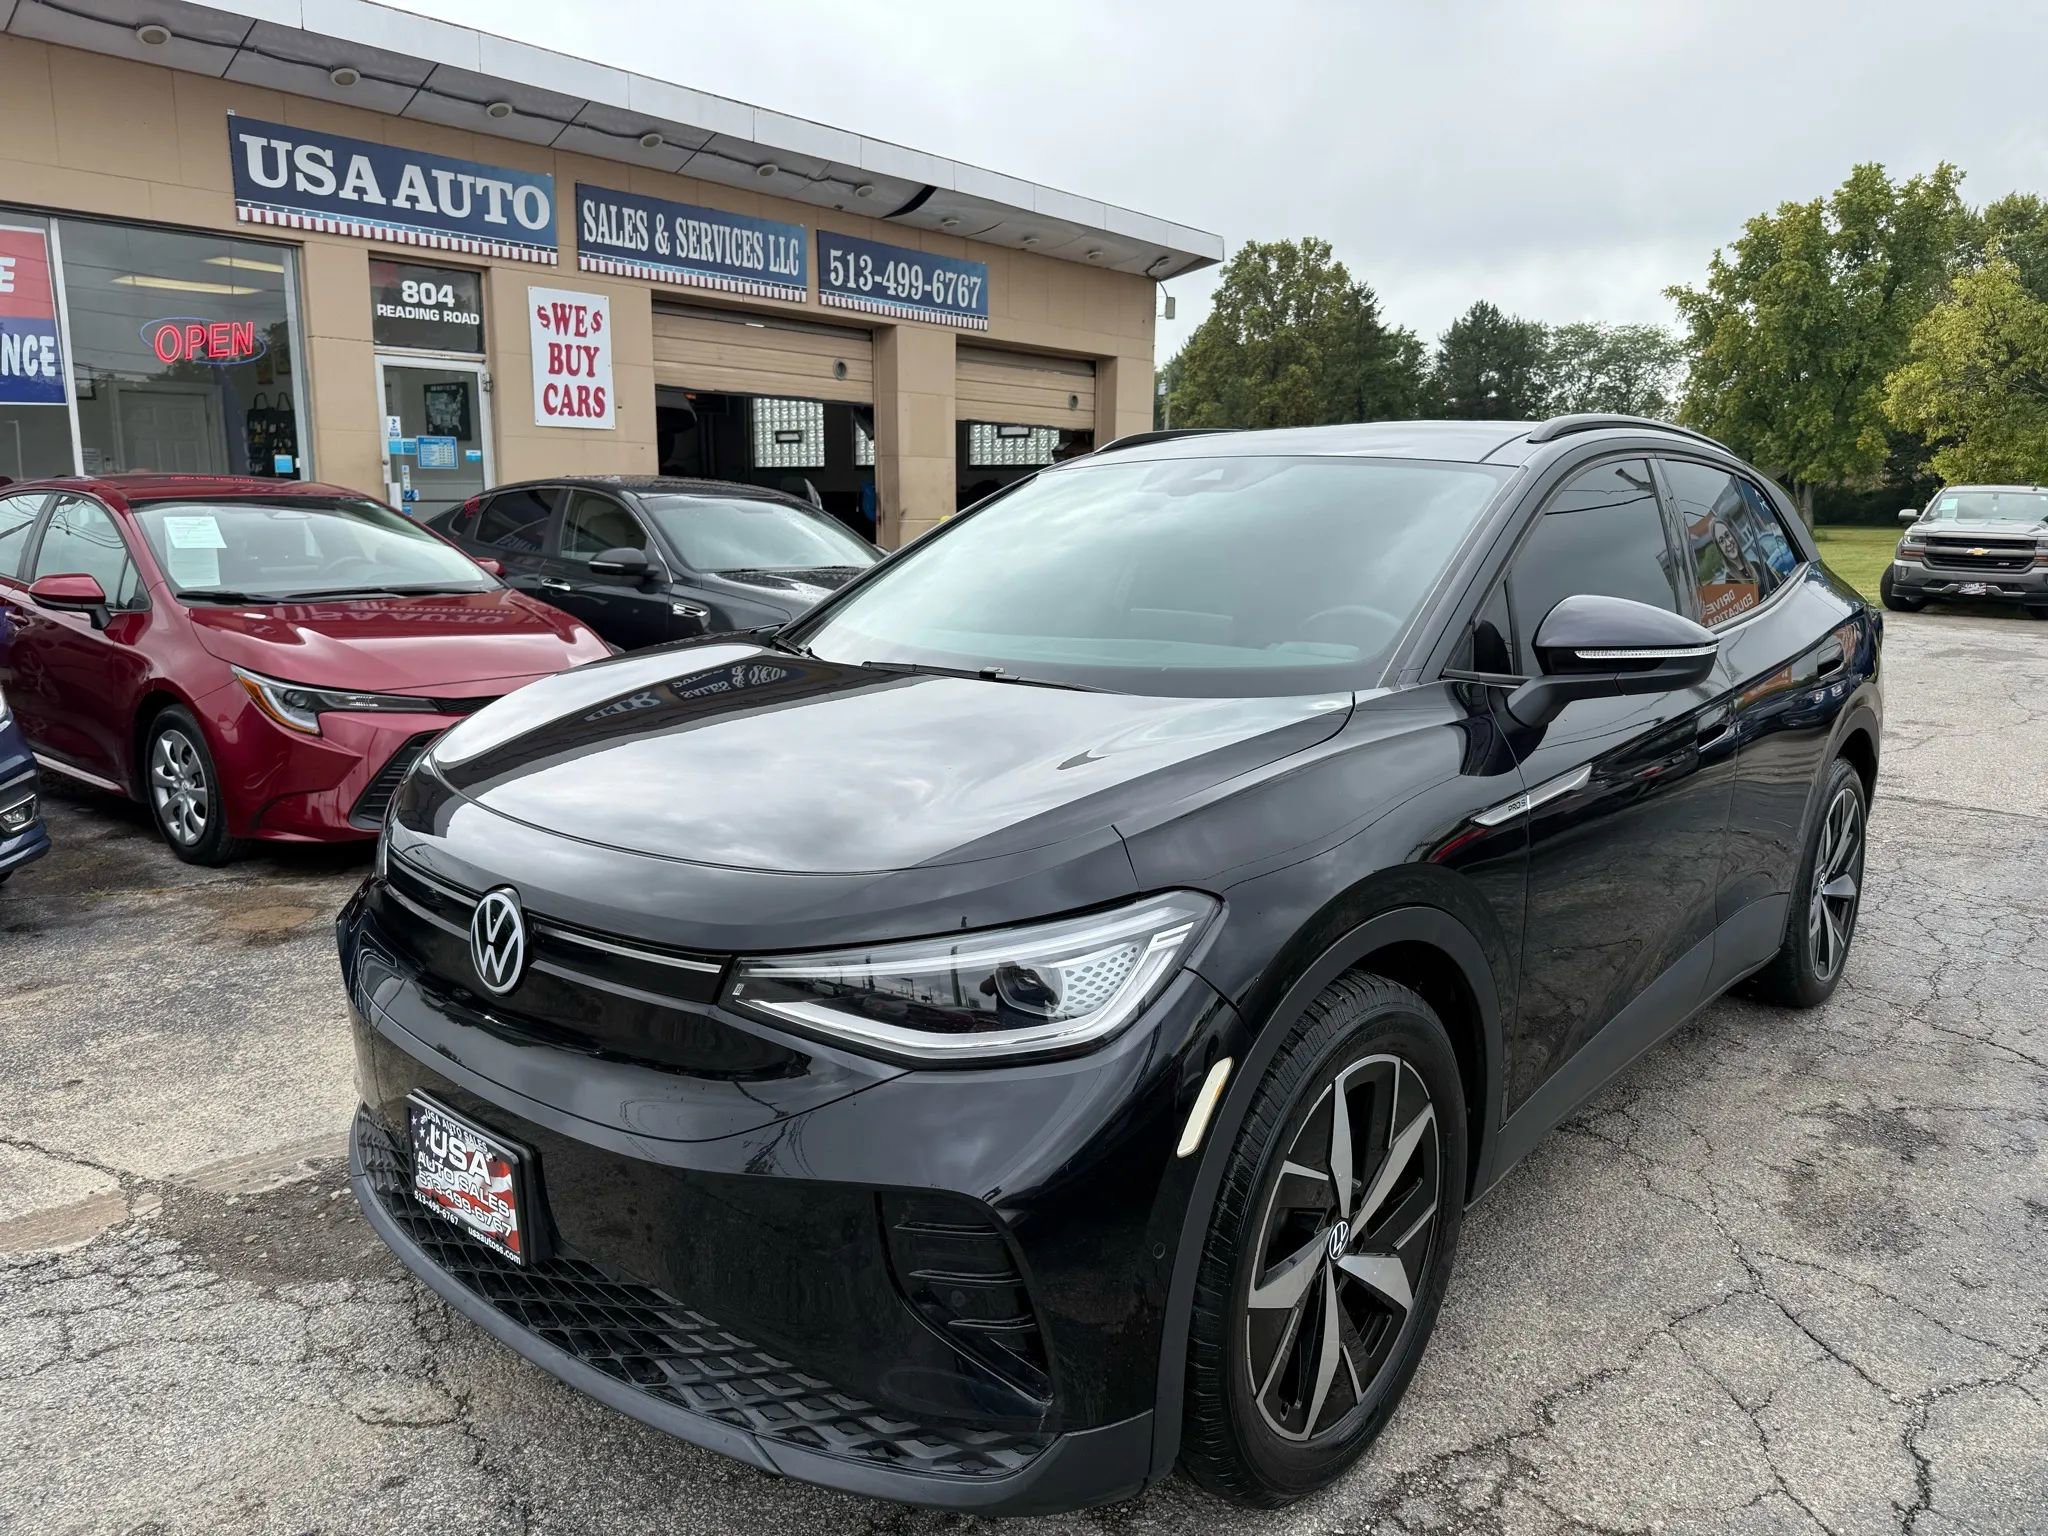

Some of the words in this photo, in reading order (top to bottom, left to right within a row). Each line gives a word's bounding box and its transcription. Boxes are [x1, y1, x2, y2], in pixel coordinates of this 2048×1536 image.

[239, 133, 387, 205] USA
[392, 164, 551, 231] AUTO
[583, 199, 649, 251] SALES
[654, 212, 671, 255] &
[675, 216, 765, 267] SERVICES
[768, 233, 800, 277] LLC
[401, 280, 455, 308] 804
[829, 249, 983, 309] 513-499-6767
[376, 303, 440, 322] READING
[443, 310, 480, 326] ROAD
[154, 321, 255, 363] OPEN
[548, 342, 600, 378] BUY
[543, 383, 606, 419] CARS
[1508, 801, 1520, 811] PRO
[425, 1108, 441, 1125] USA
[442, 1119, 462, 1138] AUTO
[463, 1131, 488, 1152] SALES
[430, 1123, 491, 1186] USA
[417, 1151, 455, 1184] AUTO
[459, 1175, 510, 1218] SALES
[414, 1190, 459, 1226] 513-499-6767
[468, 1226, 521, 1265] usaautoss.com
